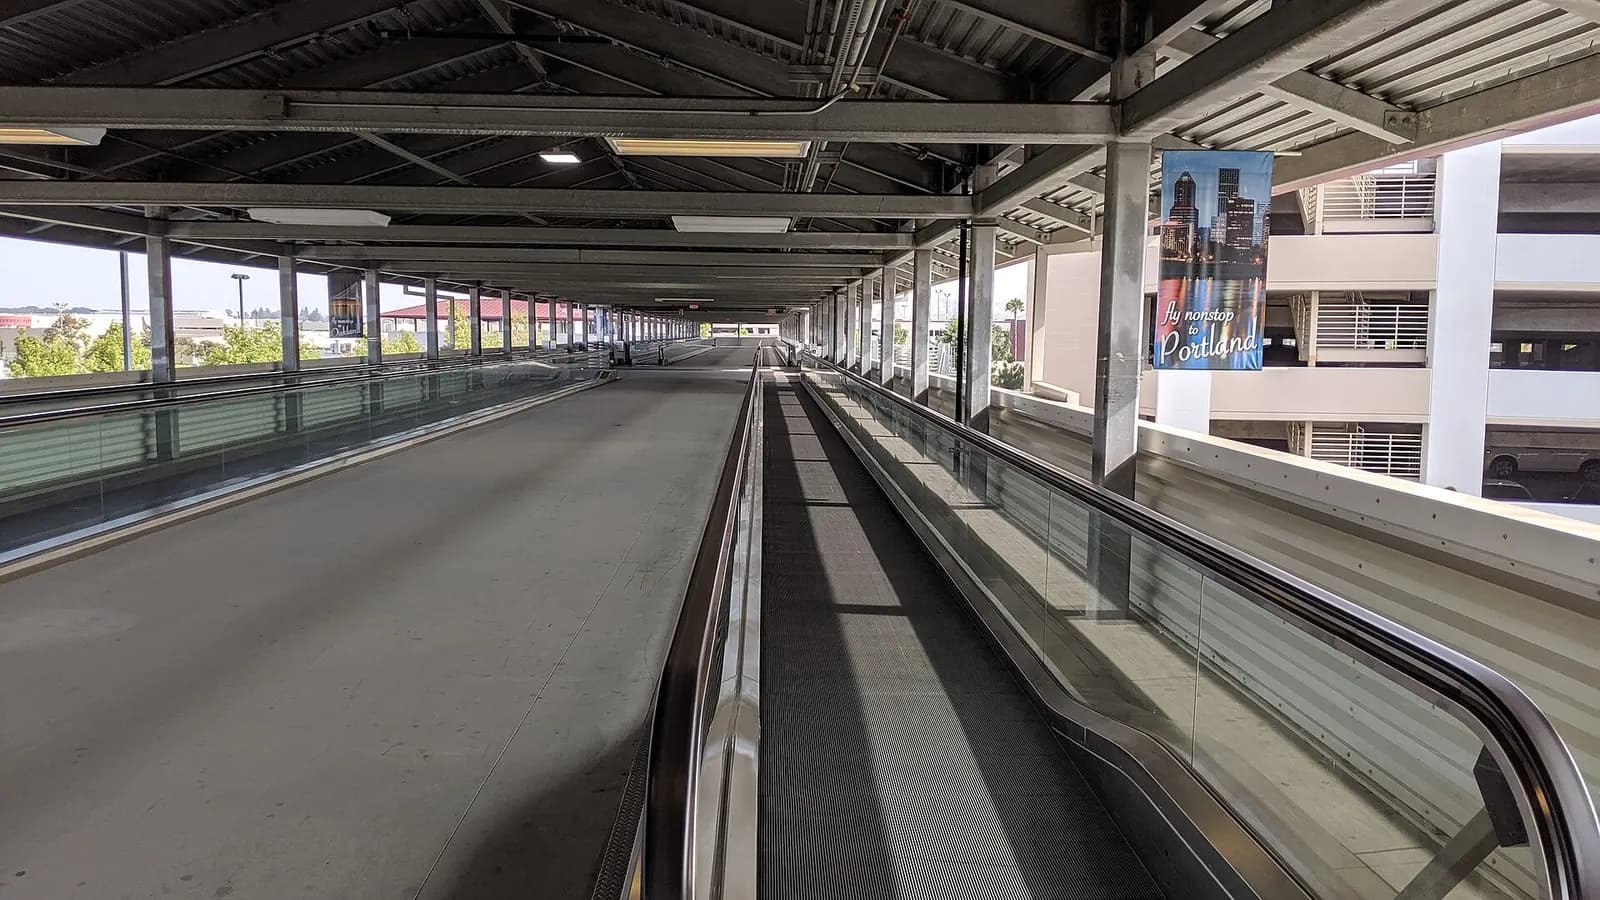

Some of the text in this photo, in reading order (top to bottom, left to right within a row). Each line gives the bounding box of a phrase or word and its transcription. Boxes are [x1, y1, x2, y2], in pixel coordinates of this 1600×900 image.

[1161, 301, 1234, 325] fly nonstop
[1160, 316, 1258, 364] Portland
[1188, 325, 1199, 335] to
